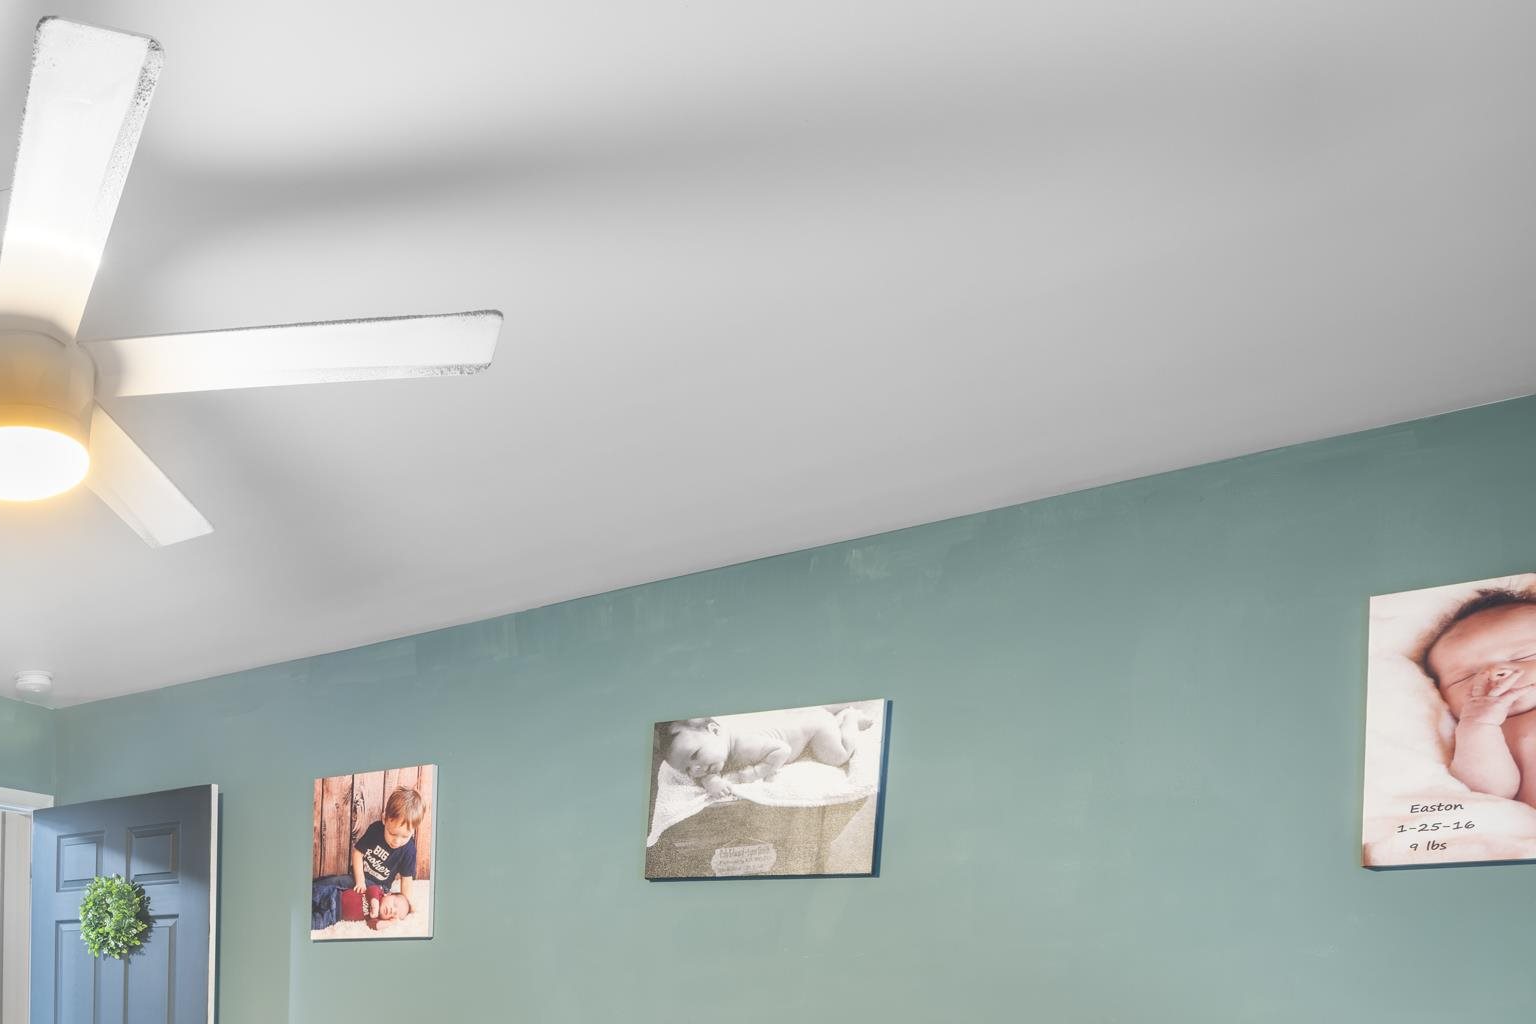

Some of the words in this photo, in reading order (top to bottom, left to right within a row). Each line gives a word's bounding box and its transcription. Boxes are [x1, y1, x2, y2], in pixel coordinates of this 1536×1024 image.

[1409, 802, 1464, 814] Easton
[1397, 821, 1475, 833] 1-25-16
[1409, 843, 1419, 851] 9
[1426, 840, 1448, 851] lbs
[373, 845, 390, 861] BIG
